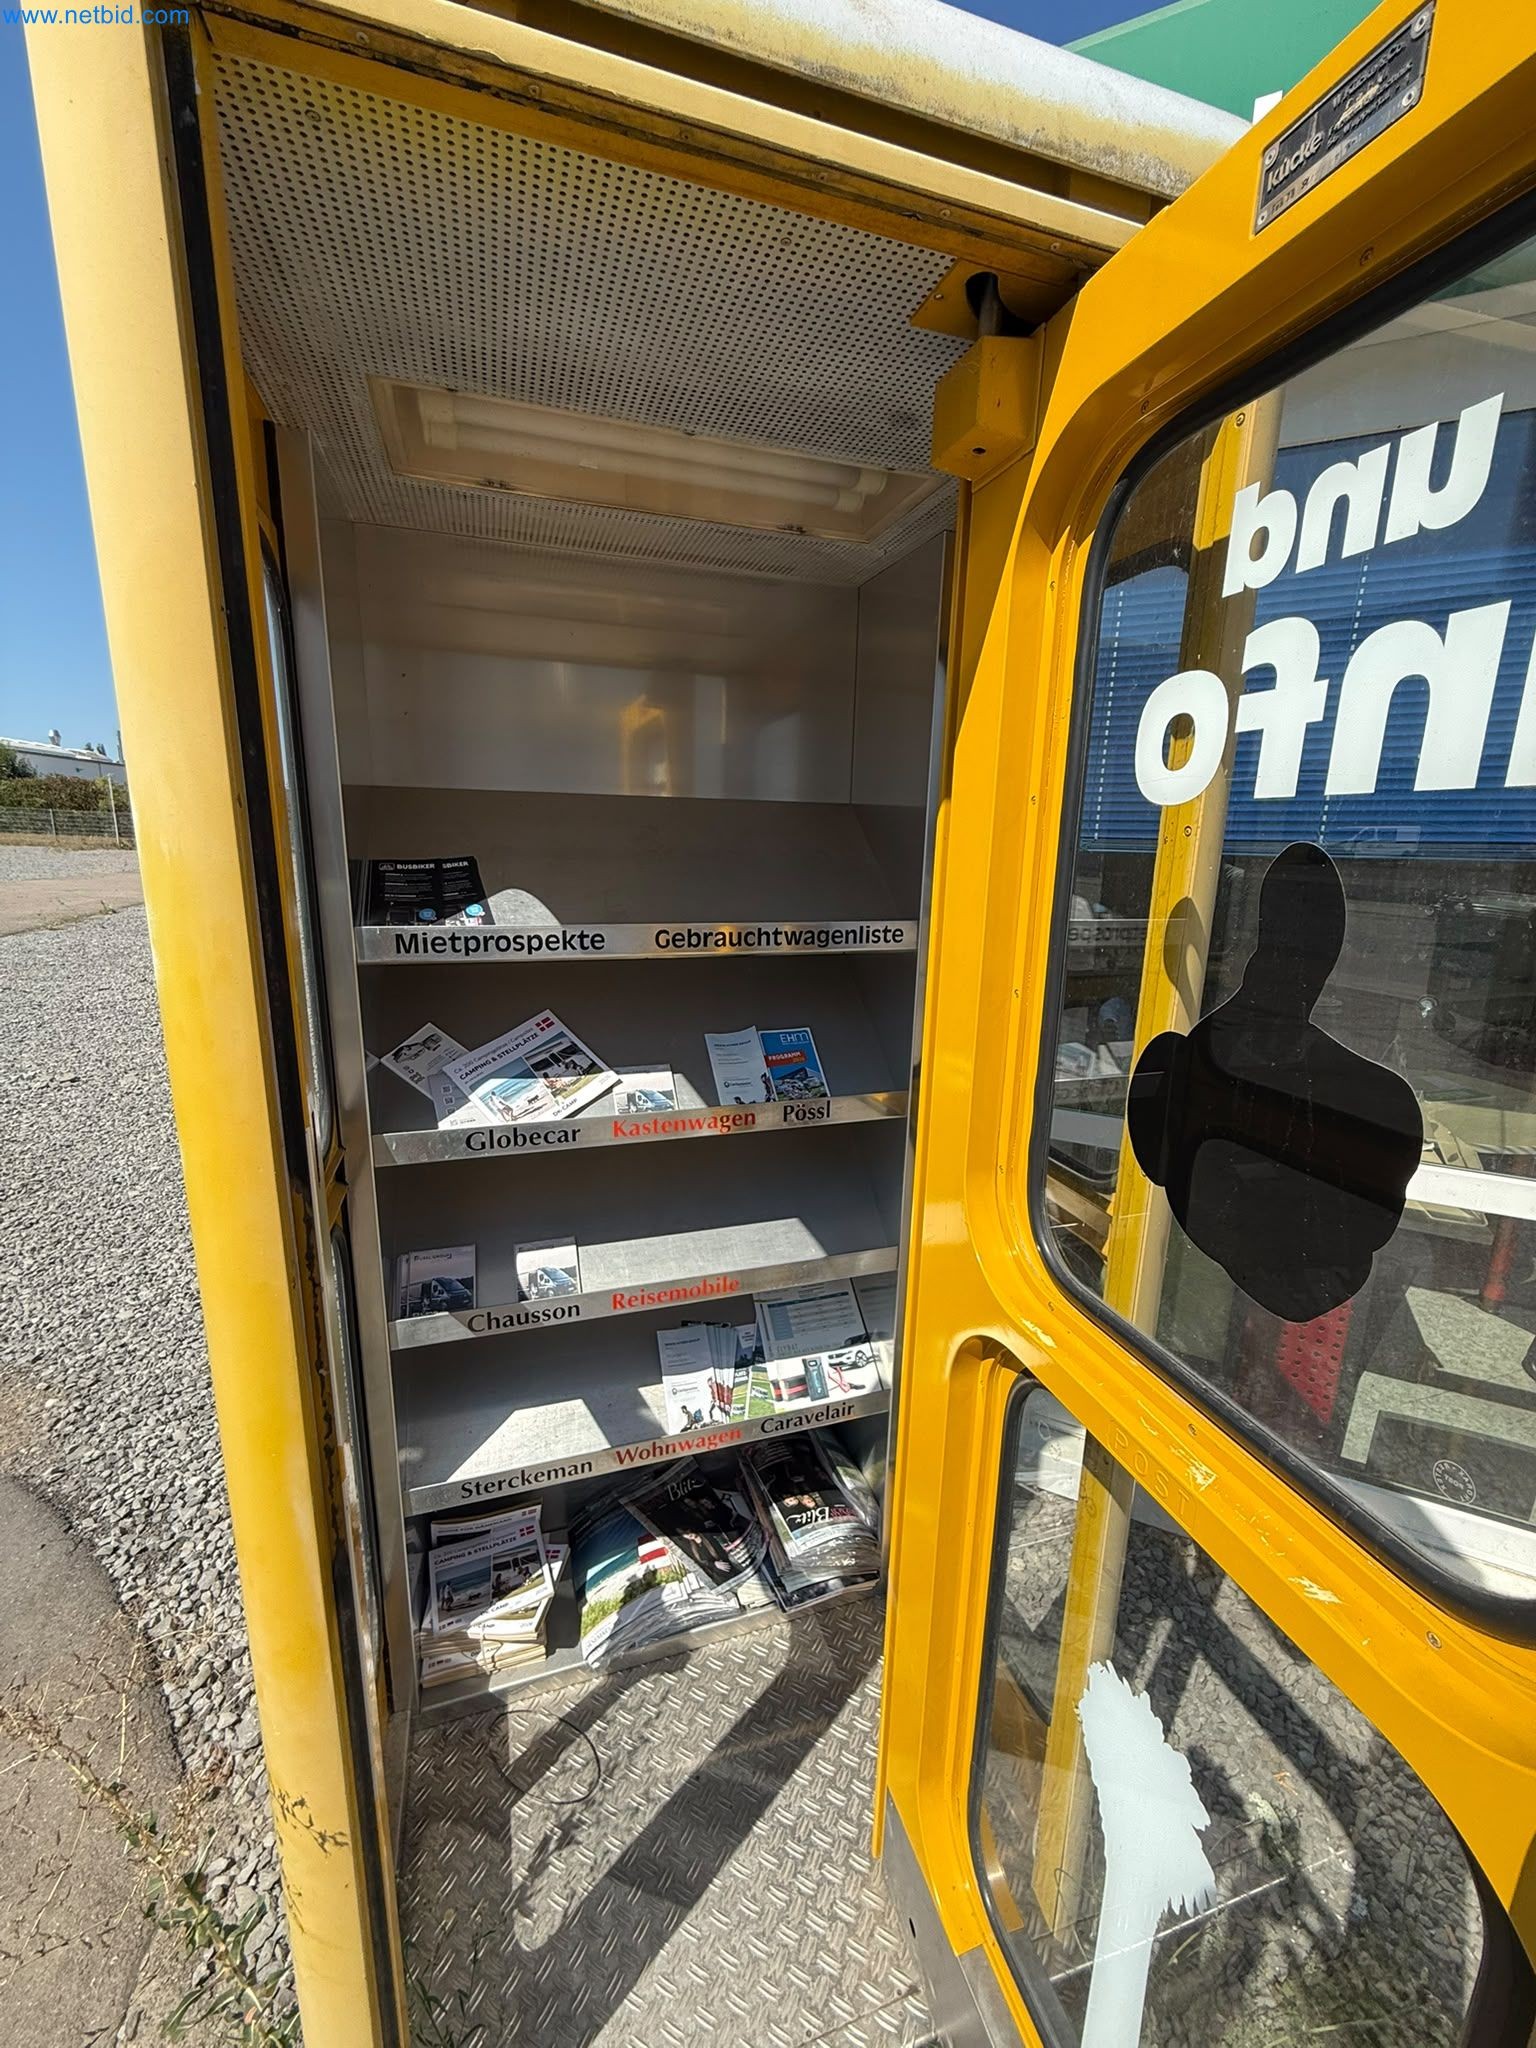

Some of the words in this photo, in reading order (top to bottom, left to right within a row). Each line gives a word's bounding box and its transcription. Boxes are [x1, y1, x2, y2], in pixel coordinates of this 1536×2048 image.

[395, 930, 606, 956] Mietprospekte
[655, 925, 904, 949] Gebrauchtwagenliste
[460, 1060, 491, 1080] CAMPING
[497, 1032, 539, 1059] STELLPLÄTZE
[466, 1126, 581, 1151] Globecar
[612, 1111, 756, 1137] Kastenwagen
[783, 1100, 831, 1123] Pössl
[468, 1304, 580, 1333] Chausson
[611, 1275, 741, 1310] Reisemobile
[461, 1460, 593, 1499] Sterckeman
[615, 1428, 743, 1466] Wohnwagen
[760, 1402, 856, 1434] Caravelair
[434, 1552, 466, 1565] CAMPING
